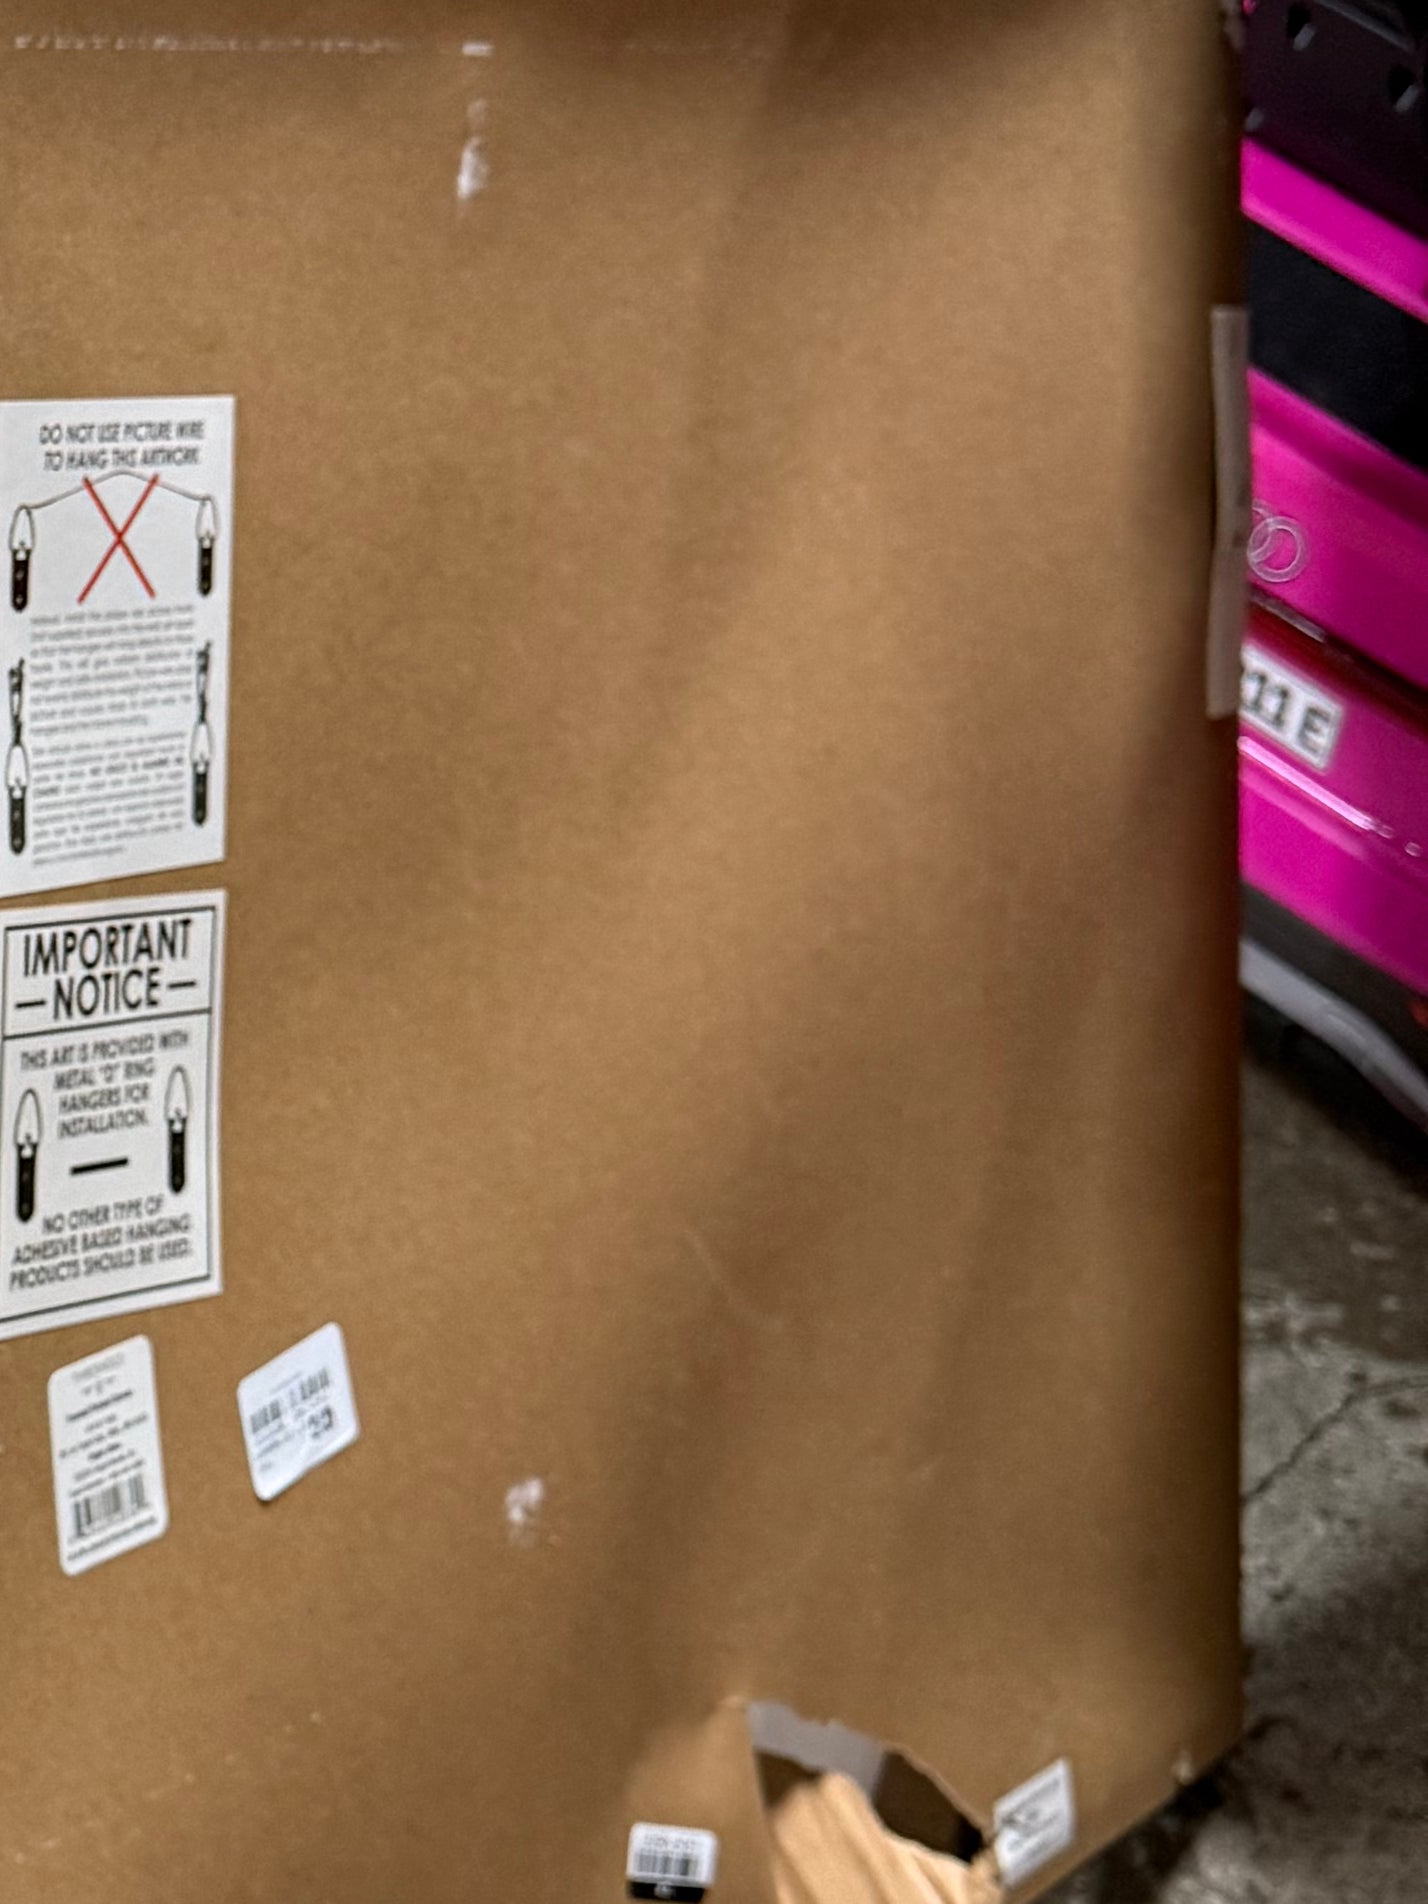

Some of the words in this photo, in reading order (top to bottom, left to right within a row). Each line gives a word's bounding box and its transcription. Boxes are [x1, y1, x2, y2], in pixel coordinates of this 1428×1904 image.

[40, 424, 62, 444] DO
[66, 423, 95, 443] NOT
[97, 422, 120, 443] USE
[123, 420, 171, 441] PICTURE
[176, 419, 204, 439] WIRE
[43, 450, 62, 471] TO
[65, 448, 108, 470] HANG
[112, 448, 136, 468] THIS
[140, 446, 200, 467] ARTWORK
[23, 918, 192, 977] IMPORTANT
[52, 967, 161, 1020] NOTICE
[20, 1049, 47, 1071] THIS
[50, 1045, 75, 1066] ART
[78, 1043, 89, 1063] IS
[92, 1033, 155, 1059] PROVIDED
[159, 1029, 189, 1050] WITH
[53, 1067, 95, 1090] METAL
[124, 1056, 155, 1080] RING
[58, 1086, 121, 1114] HANGERS
[124, 1081, 150, 1103] FOR
[43, 1212, 64, 1234] NO
[68, 1204, 109, 1229] OTHER
[112, 1197, 143, 1220] TYPE
[145, 1193, 163, 1215] OF
[11, 1233, 78, 1264] ADHESIVE
[81, 1226, 122, 1251] BASED
[126, 1212, 190, 1242] HANGING
[9, 1258, 80, 1291] PRODUCTS
[83, 1247, 136, 1276] SHOULD
[139, 1243, 154, 1265] BE
